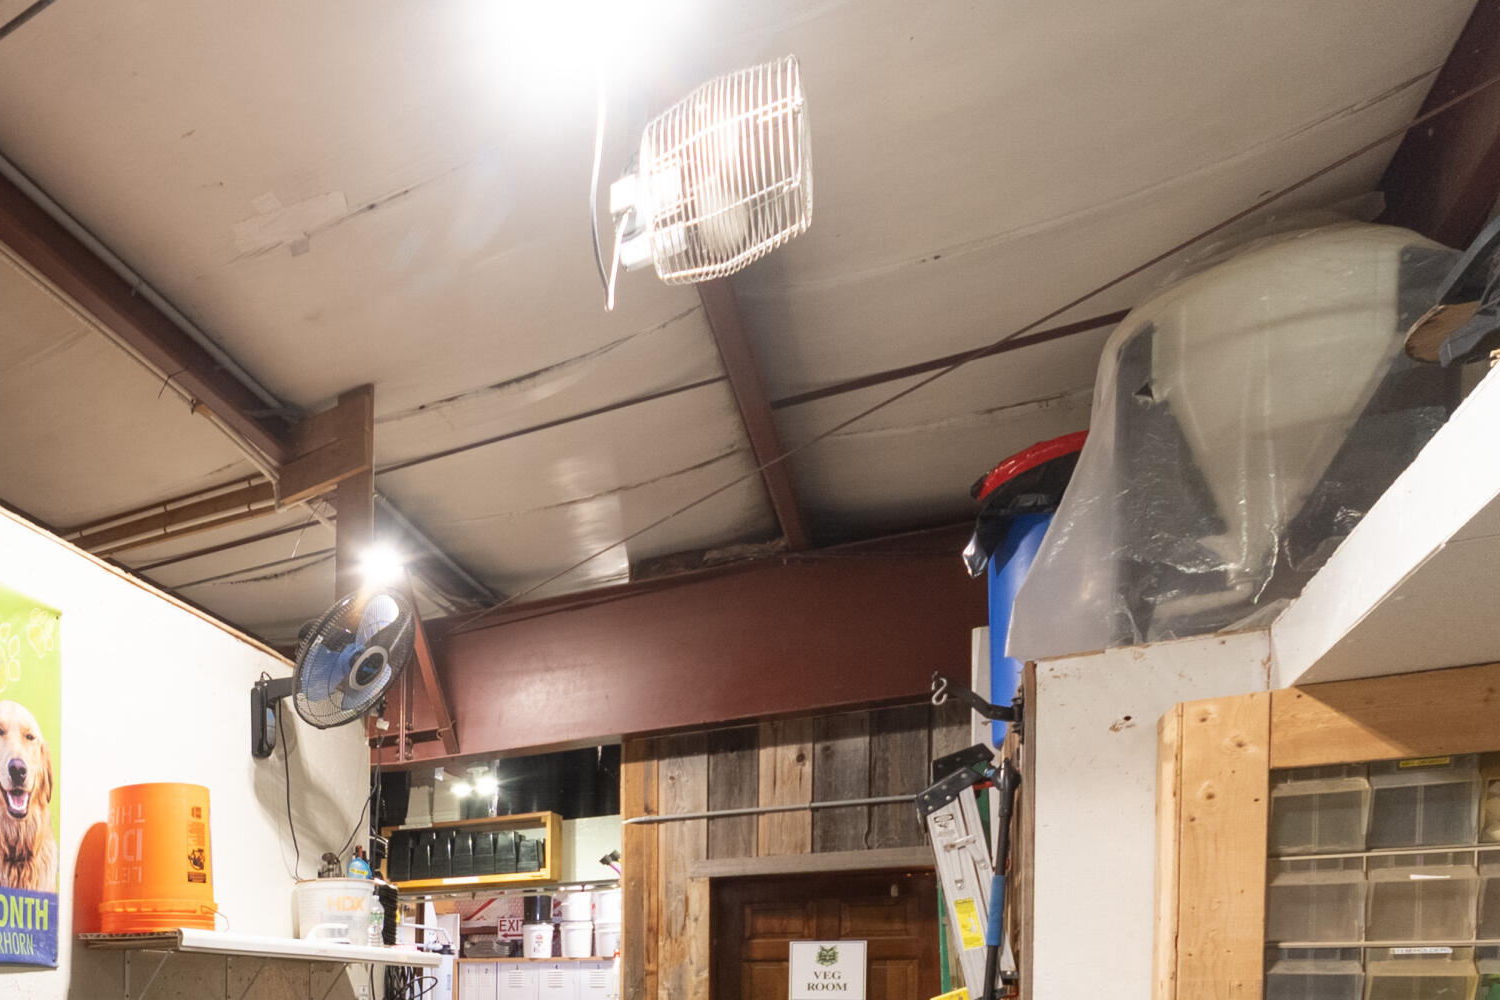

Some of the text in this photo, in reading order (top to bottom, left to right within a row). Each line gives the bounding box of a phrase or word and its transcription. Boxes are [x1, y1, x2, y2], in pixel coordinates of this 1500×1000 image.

[327, 896, 364, 911] HDX
[813, 971, 842, 980] VEG
[807, 982, 847, 992] ROOM
